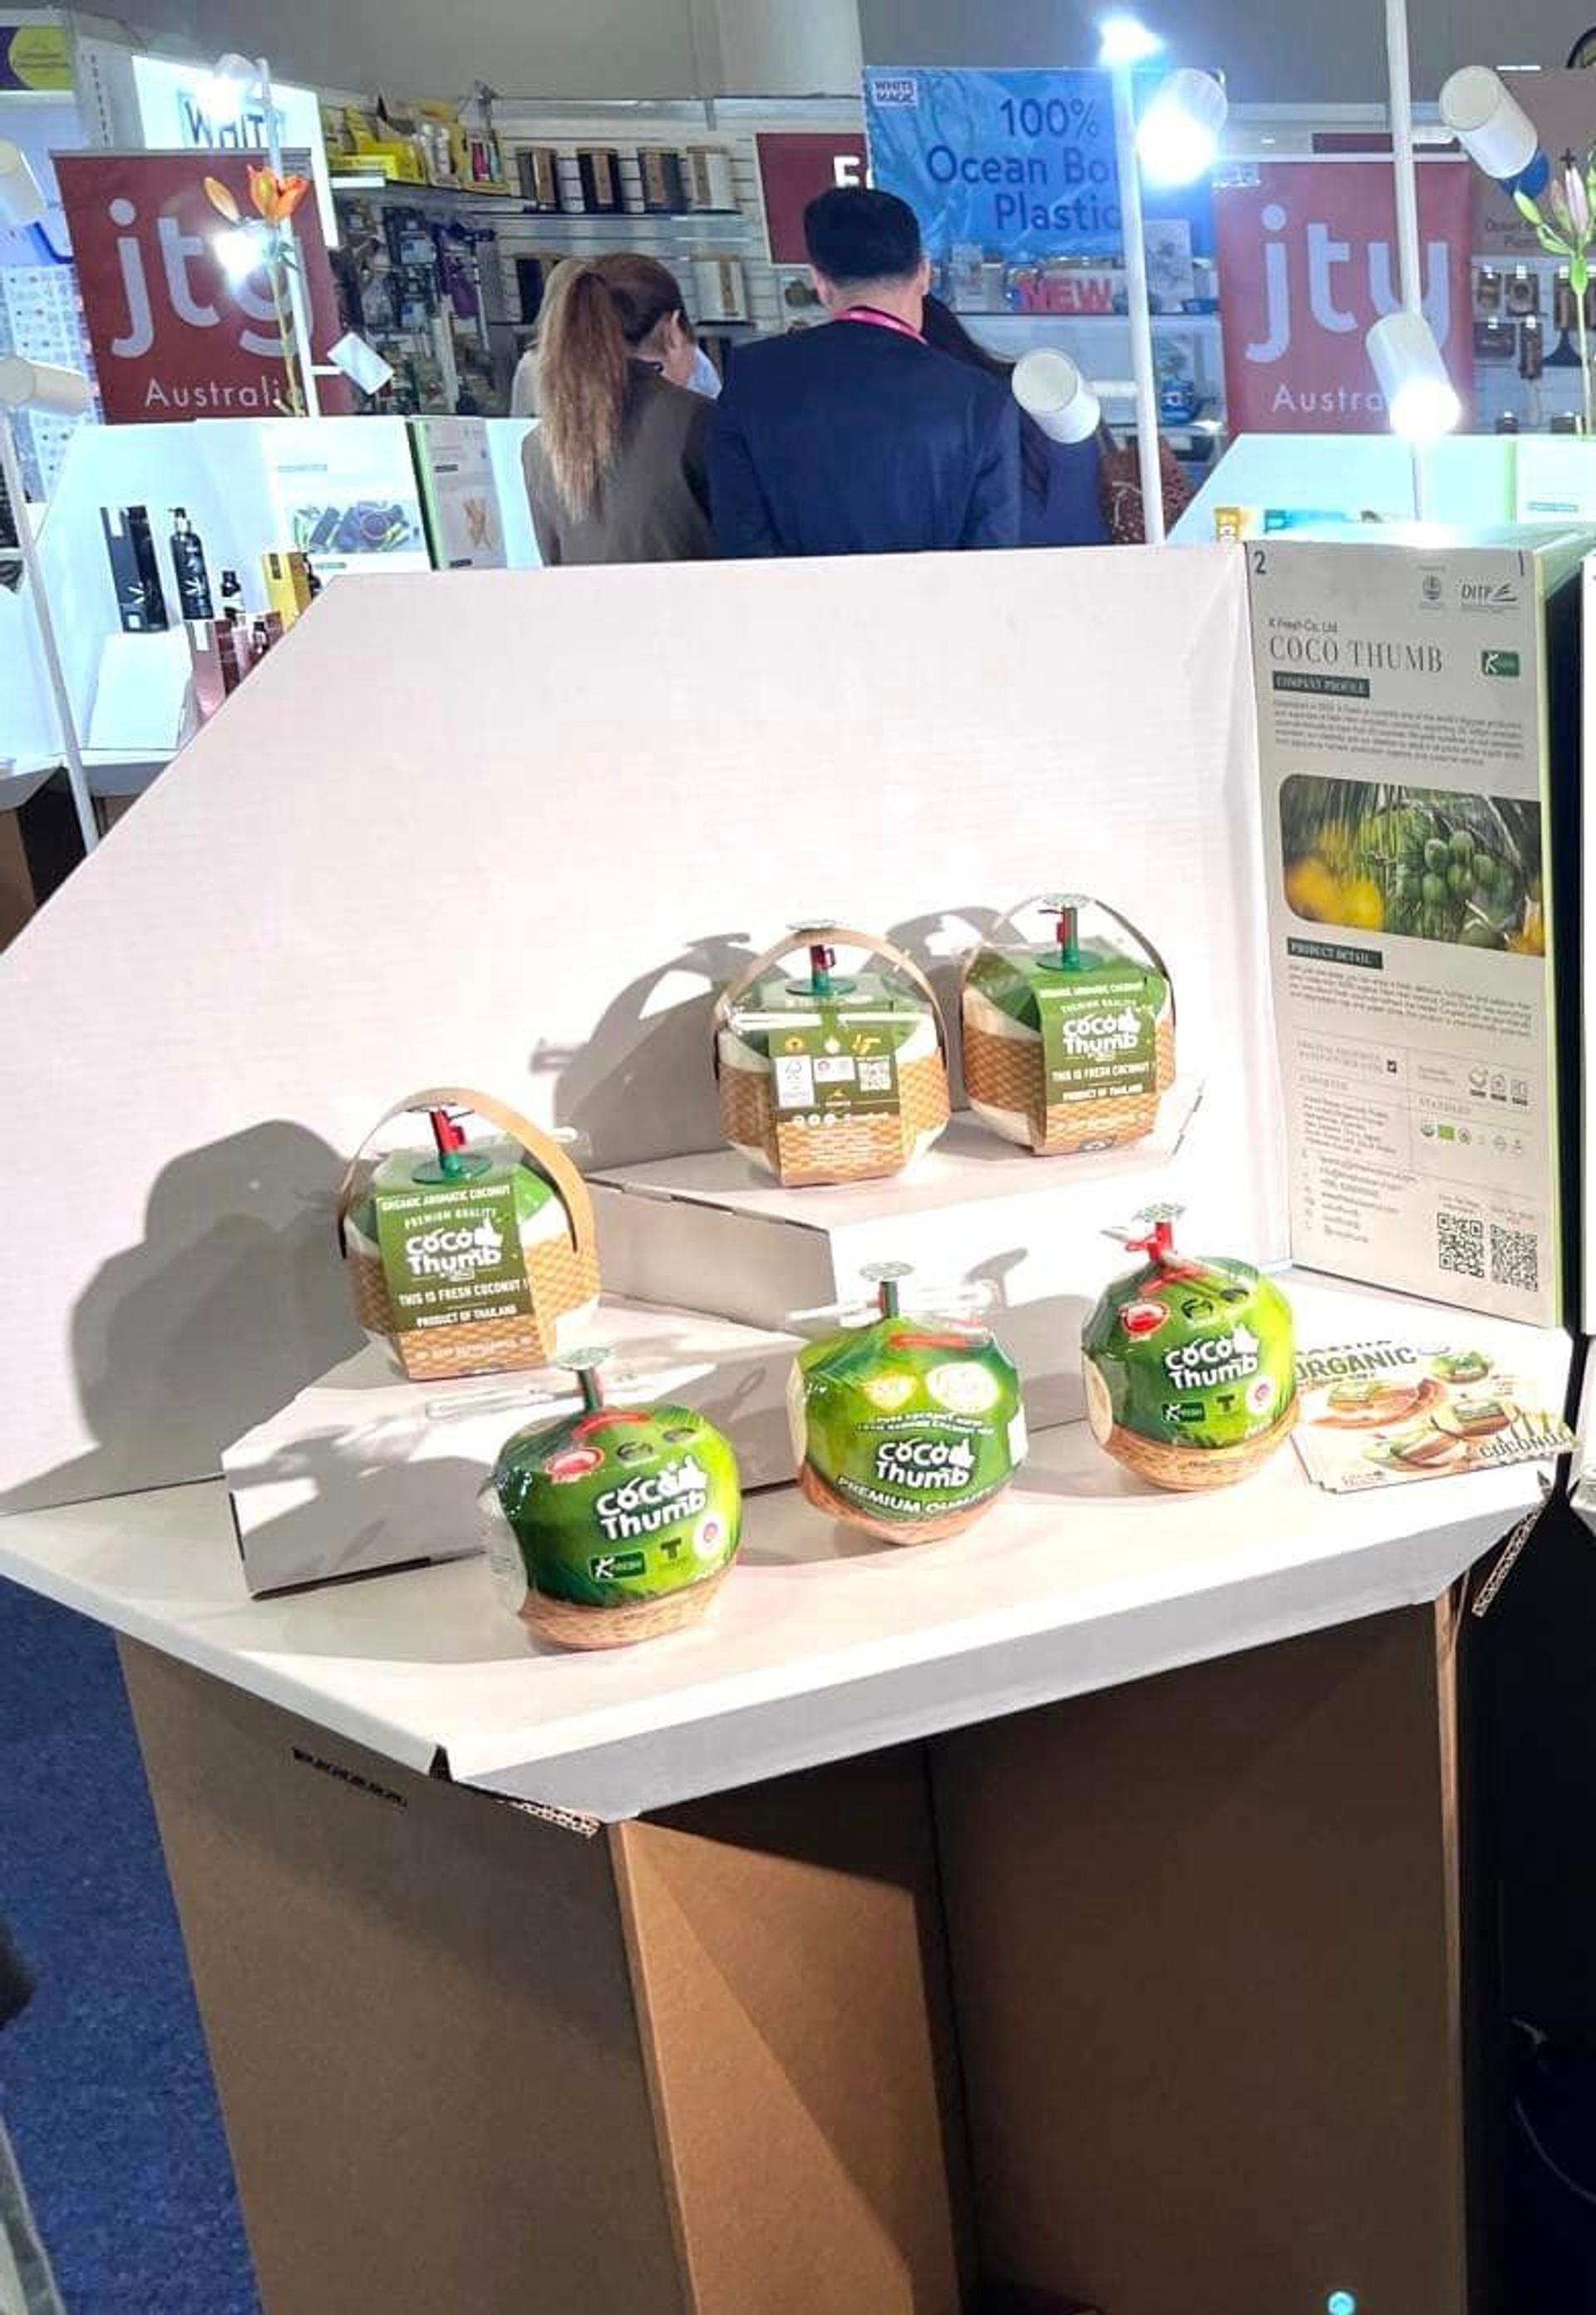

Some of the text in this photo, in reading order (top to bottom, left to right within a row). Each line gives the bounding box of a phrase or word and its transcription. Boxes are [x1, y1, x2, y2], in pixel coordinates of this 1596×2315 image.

[1000, 97, 1097, 138] 100%
[927, 145, 1048, 185] Ocean
[995, 190, 1122, 231] Plastic
[1019, 274, 1112, 311] NEW
[1244, 204, 1451, 363] jty
[145, 376, 284, 408] Australi
[1272, 382, 1388, 413] Austra
[1253, 550, 1267, 574] 2
[1270, 635, 1443, 672] COCO THUMB
[406, 1248, 502, 1276] Thumb
[398, 1292, 424, 1307] THIS
[425, 1291, 436, 1303] IS
[438, 1286, 472, 1303] FRESH
[474, 1280, 521, 1297] COCONUT
[416, 1312, 459, 1328] PRODUCT
[472, 1304, 518, 1320] THAILAND
[1168, 1354, 1259, 1390] Thumb
[875, 1460, 970, 1489] Thumb
[837, 1476, 921, 1514] PREMIUM
[598, 1492, 707, 1540] Thumb
